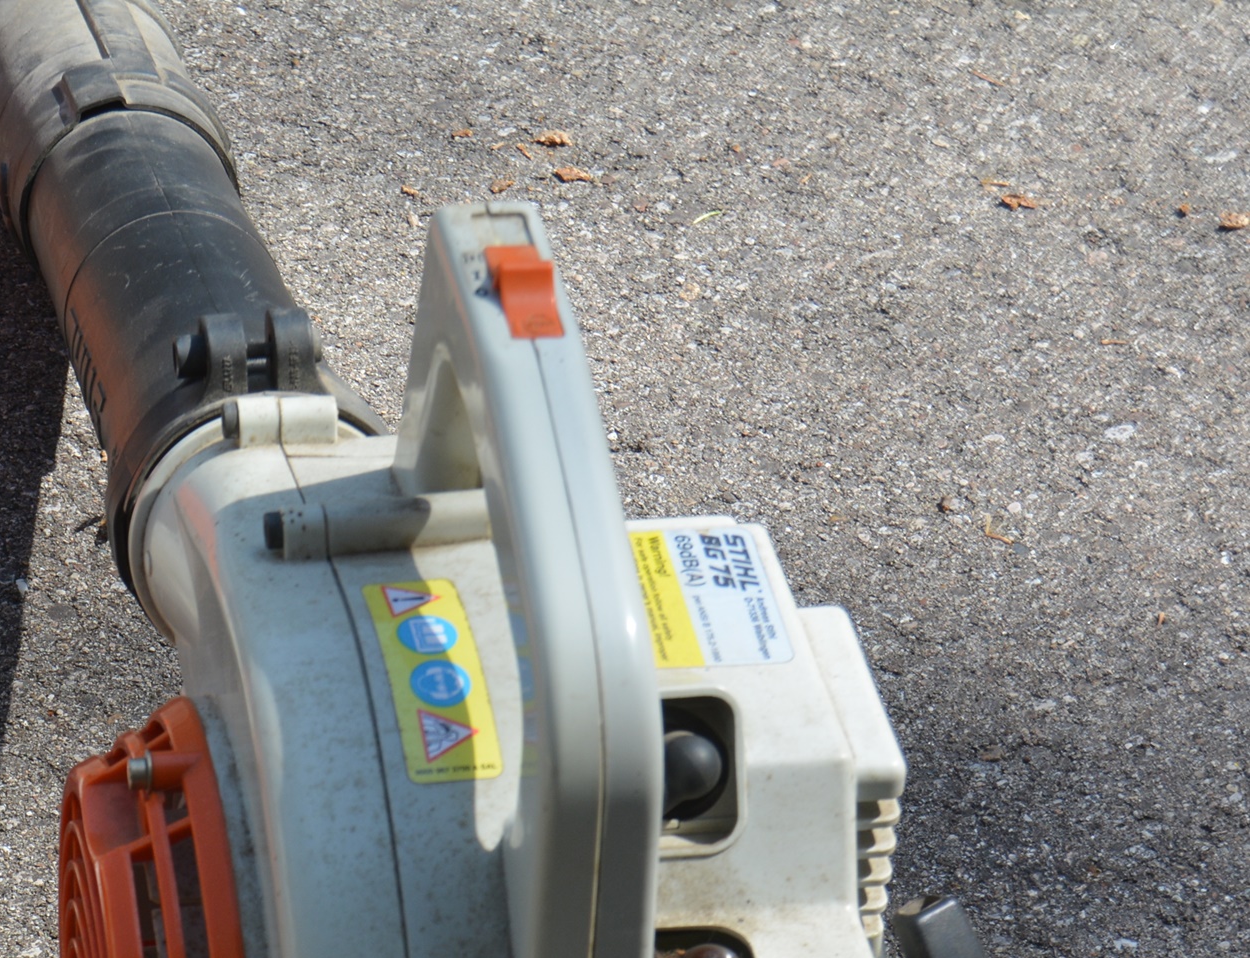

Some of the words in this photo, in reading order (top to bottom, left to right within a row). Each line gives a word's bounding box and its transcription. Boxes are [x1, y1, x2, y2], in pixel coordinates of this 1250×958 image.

[674, 535, 706, 587] 69dB(A)
[700, 534, 726, 560] BG
[724, 534, 760, 591] STIHL
[709, 564, 736, 589] 75
